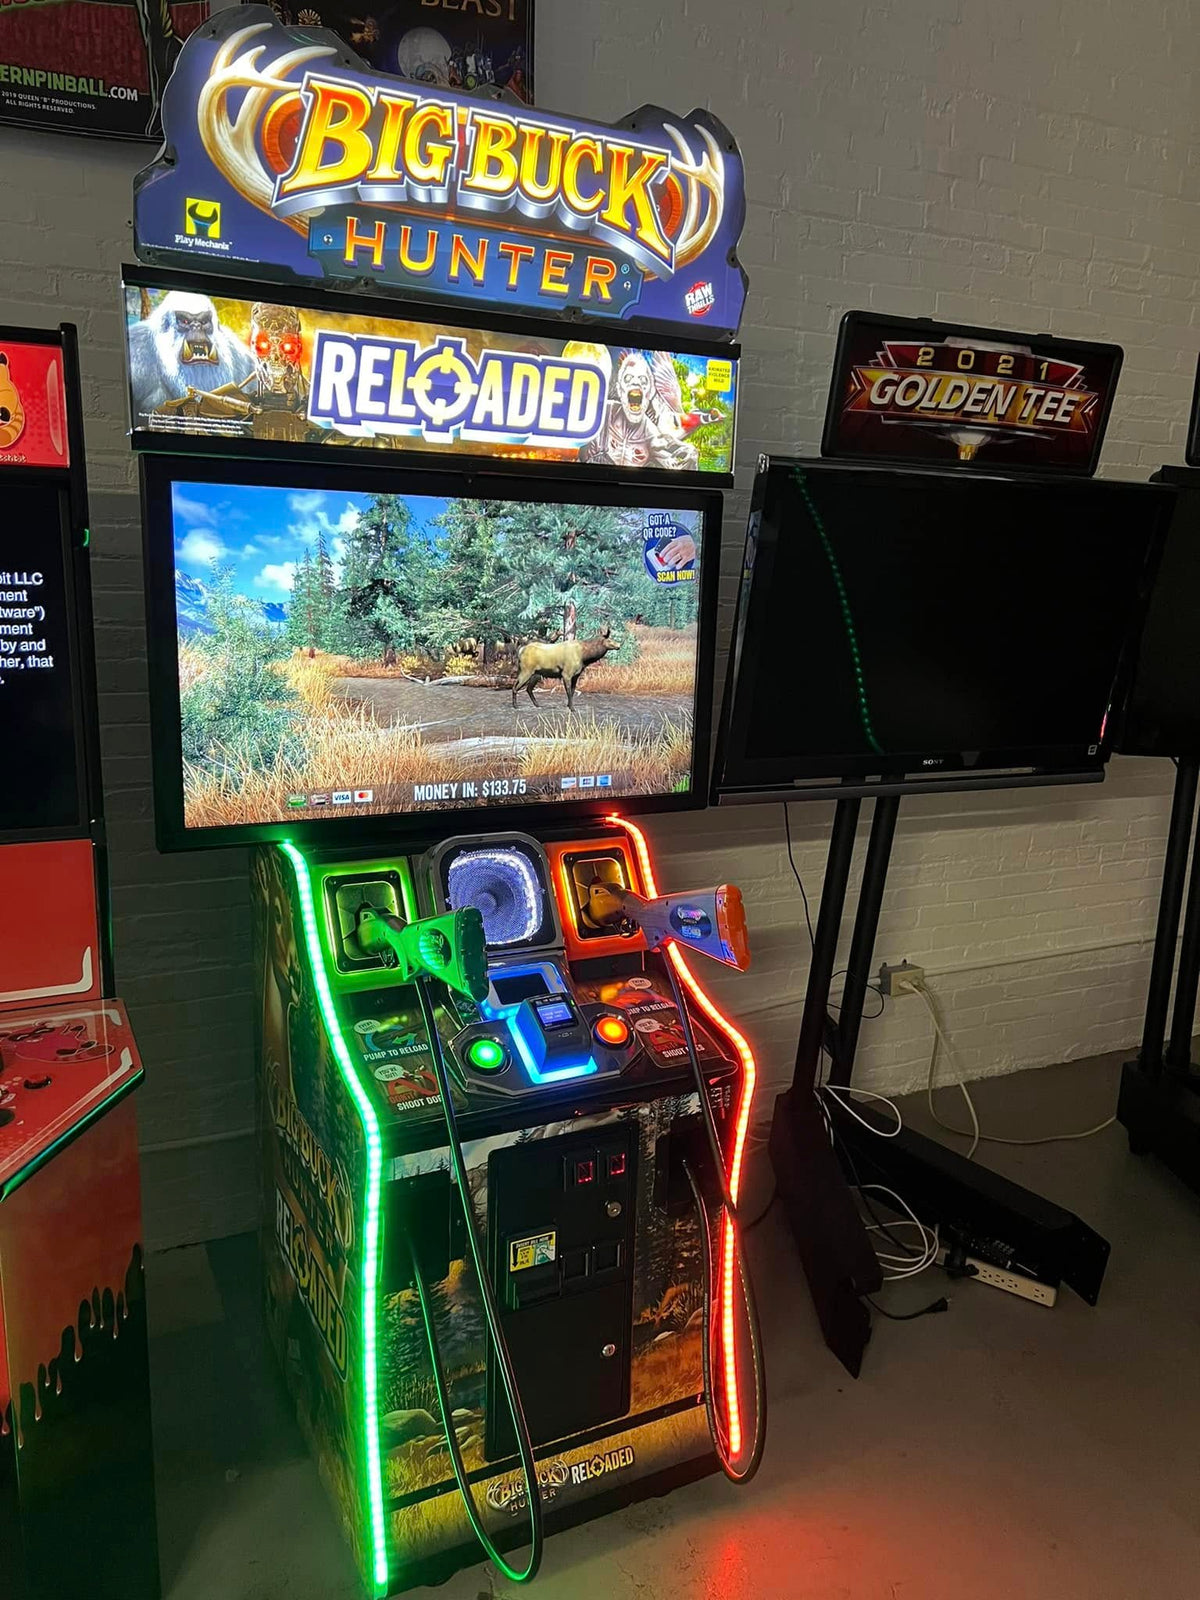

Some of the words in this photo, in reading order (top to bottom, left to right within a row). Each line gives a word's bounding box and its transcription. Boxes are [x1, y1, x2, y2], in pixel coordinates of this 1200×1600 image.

[5, 98, 17, 106] ALL
[18, 100, 41, 109] RIGHTS
[18, 93, 40, 102] QUEEN
[274, 76, 457, 200] BIG
[465, 112, 674, 265] BUCK
[174, 234, 194, 248] Play
[343, 216, 617, 302] HUNTER
[684, 282, 713, 307] RAW
[316, 339, 602, 434] RELOADED
[868, 373, 1017, 417] GOLDEN
[1021, 388, 1081, 424] TEE
[649, 514, 664, 526] GOT
[664, 513, 671, 525] A
[643, 528, 654, 540] QR
[654, 526, 677, 538] CODE?
[14, 571, 44, 585] LLC
[656, 571, 676, 582] SCAN
[676, 569, 695, 580] NOW!
[0, 638, 18, 655] by
[20, 638, 47, 651] and
[28, 655, 54, 668] that
[922, 758, 945, 766] SONY
[414, 784, 458, 801] MONEY
[462, 783, 478, 798] IN:
[482, 779, 527, 797] $133.75
[363, 1051, 387, 1062] PUMP
[387, 1049, 399, 1058] TO
[399, 1044, 429, 1055] RELOAD
[396, 1098, 425, 1111] SHOOT
[571, 1447, 635, 1485] RELOADED
[498, 1480, 524, 1507] BIG
[510, 1488, 557, 1512] HUER
